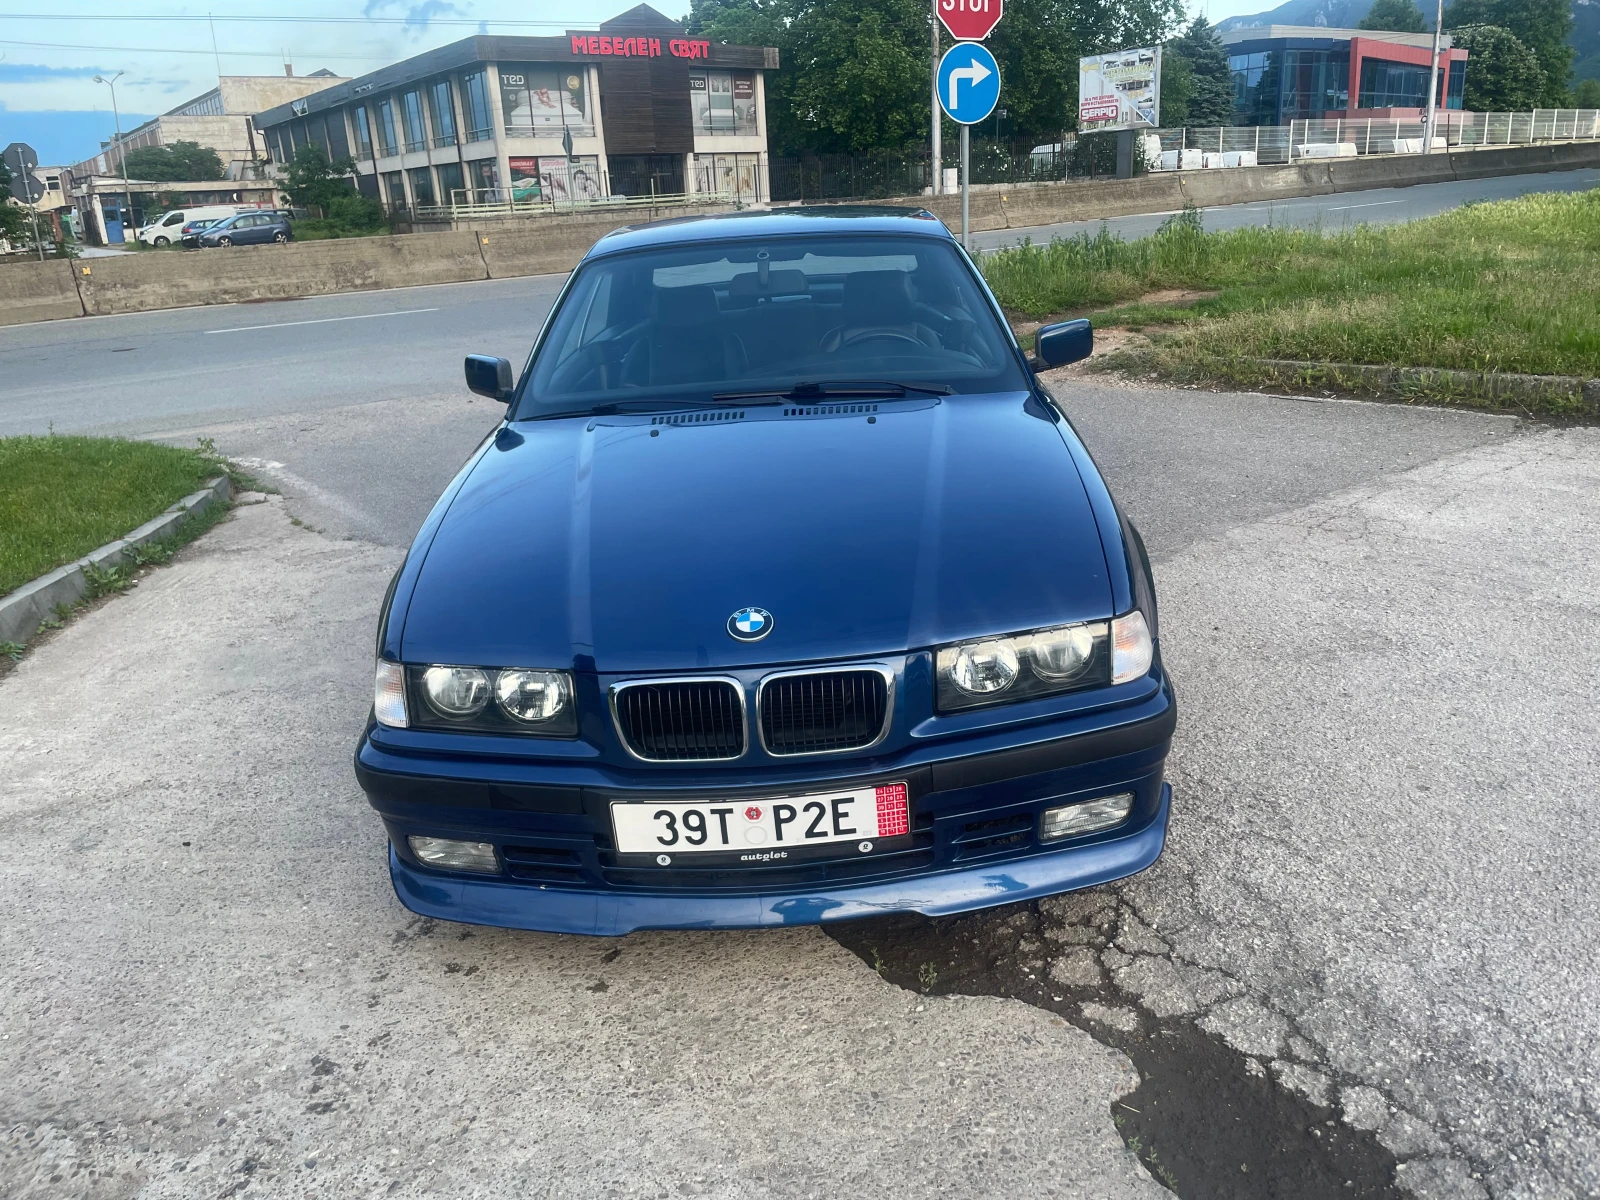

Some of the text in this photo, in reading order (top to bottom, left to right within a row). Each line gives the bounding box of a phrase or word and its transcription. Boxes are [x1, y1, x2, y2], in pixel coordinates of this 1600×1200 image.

[571, 36, 710, 59] МЕБЕЛЕН СВЯТ
[733, 608, 769, 618] BMW
[653, 808, 733, 846] 39T
[772, 797, 857, 841] P2E
